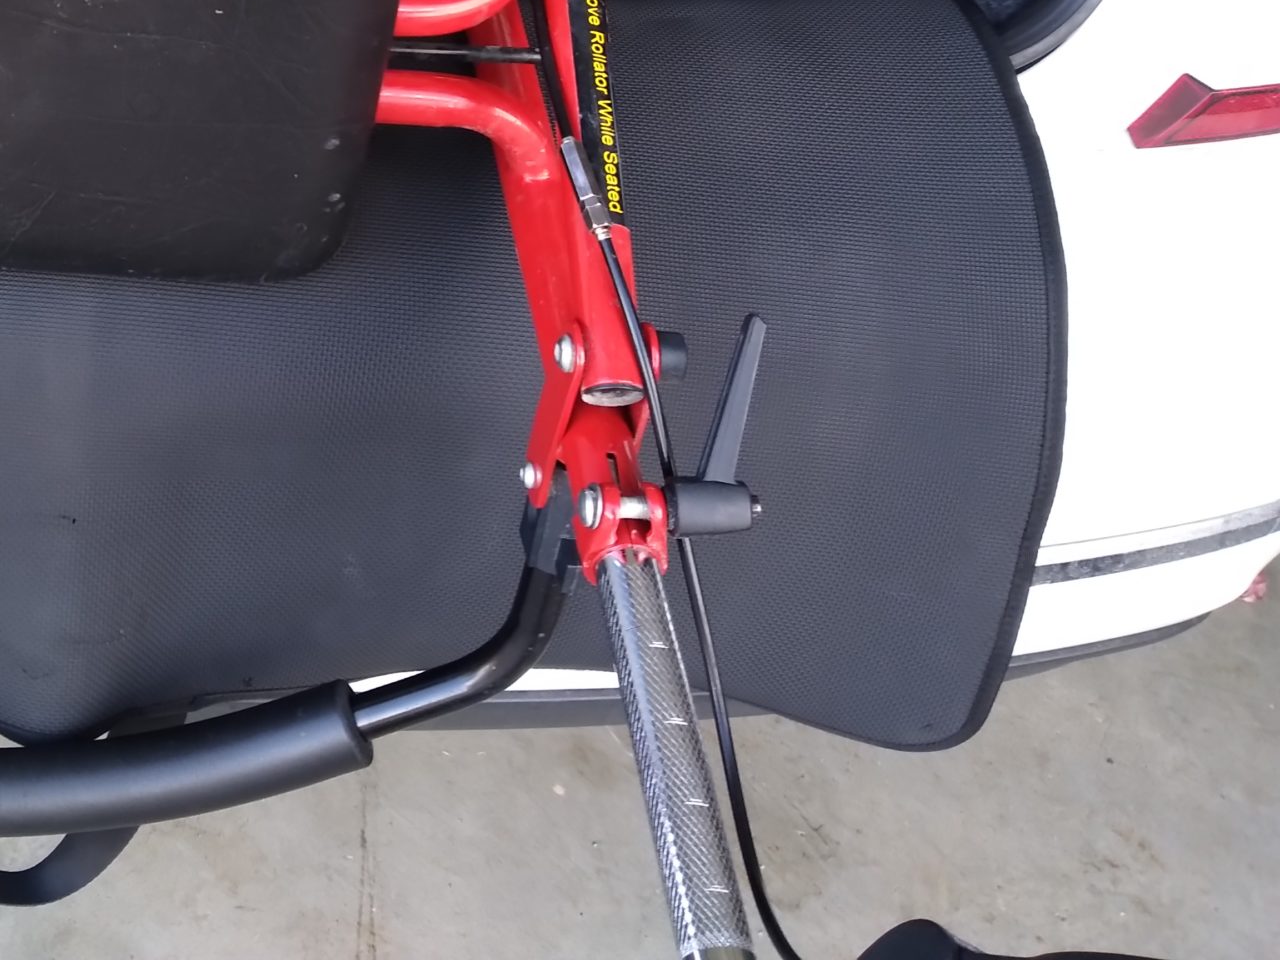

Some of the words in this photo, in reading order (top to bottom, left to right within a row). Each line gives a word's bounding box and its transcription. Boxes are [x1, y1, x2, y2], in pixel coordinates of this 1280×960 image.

[590, 30, 609, 96] Rollator
[597, 99, 615, 147] While
[602, 150, 623, 214] Seated
